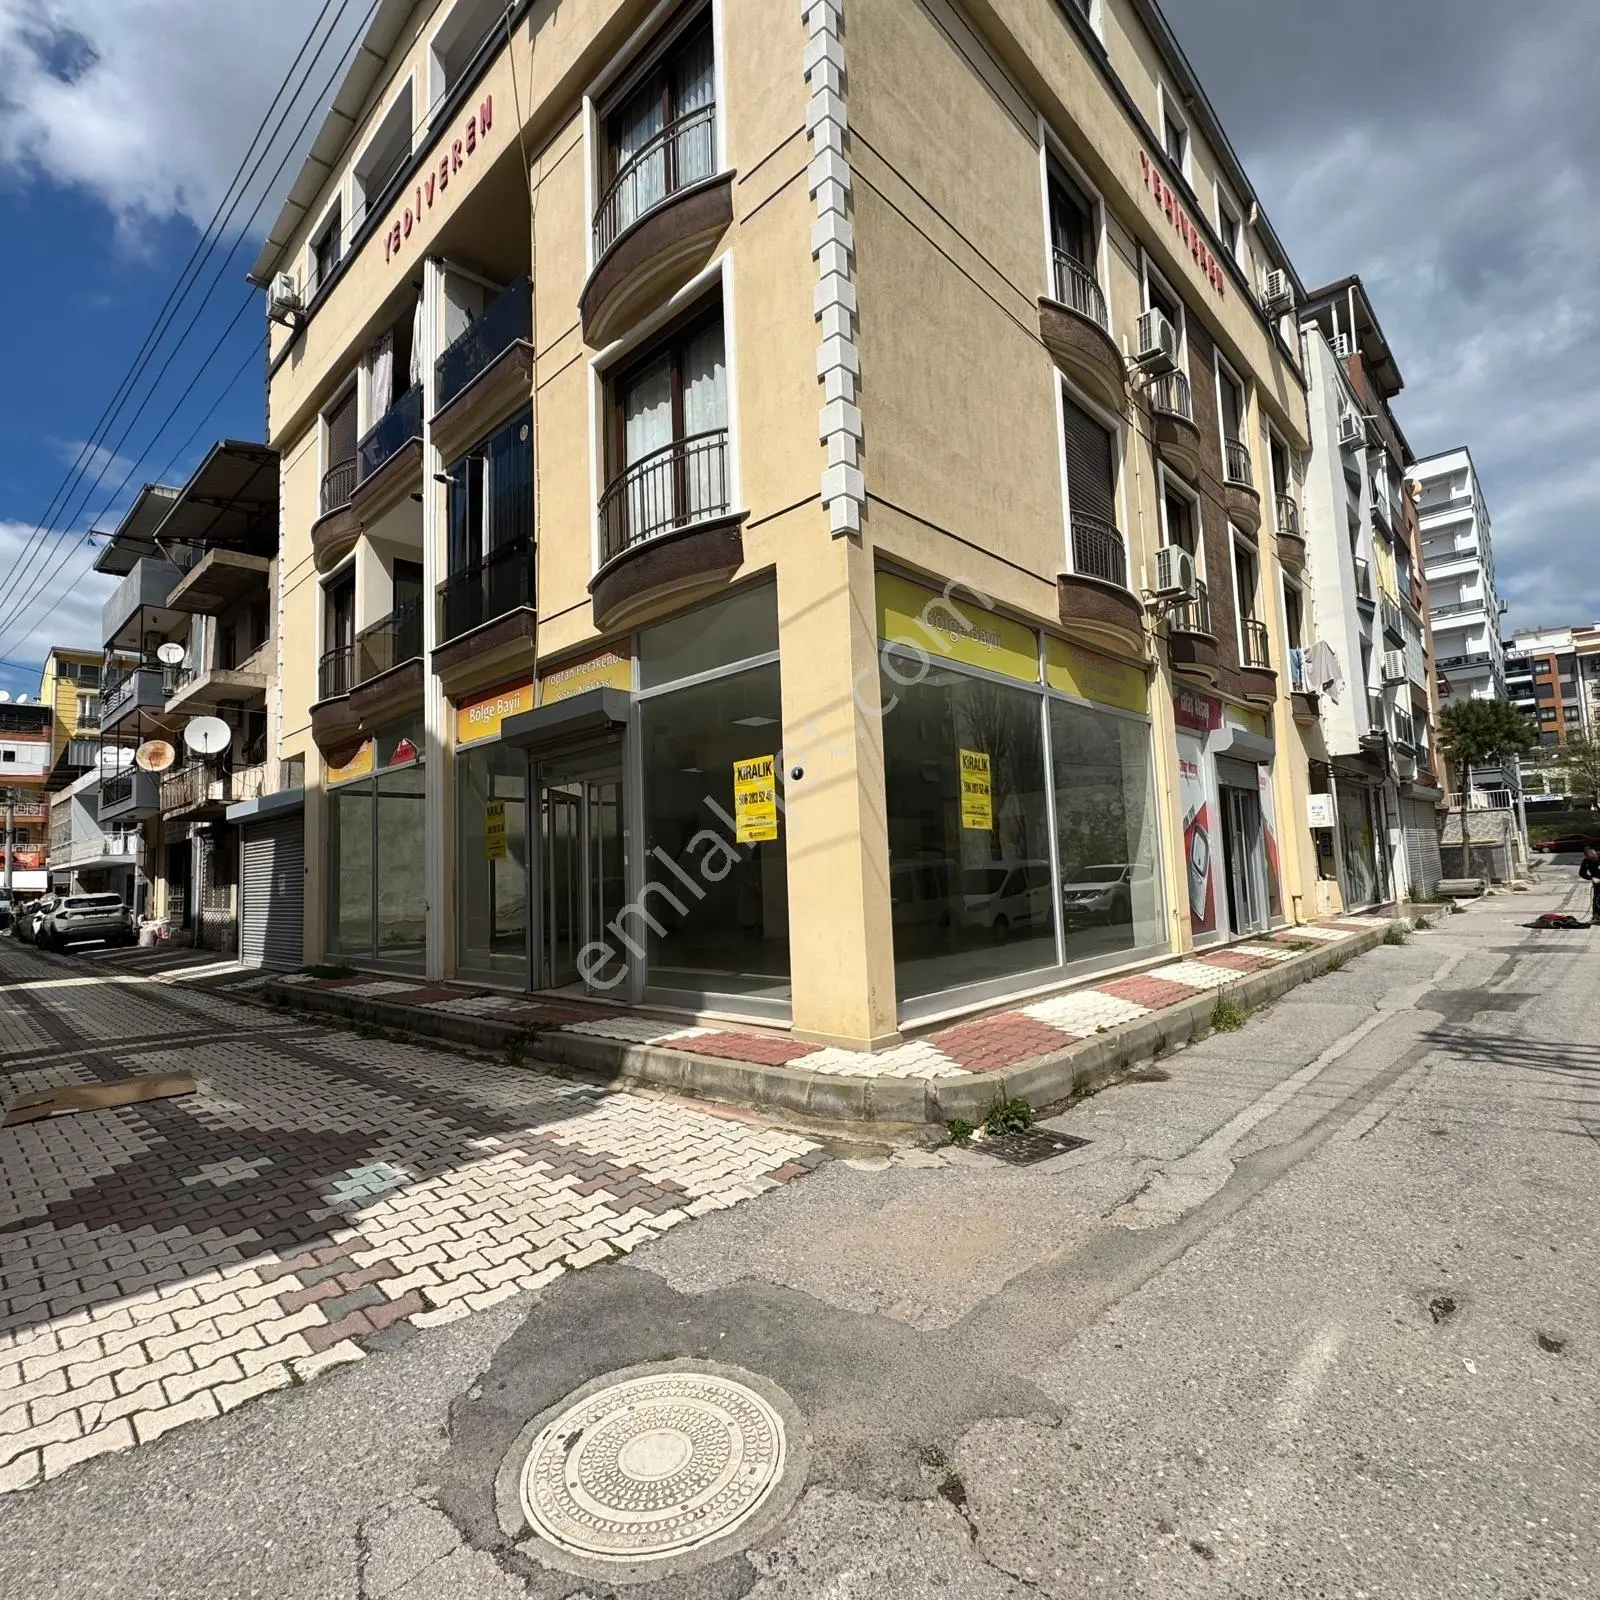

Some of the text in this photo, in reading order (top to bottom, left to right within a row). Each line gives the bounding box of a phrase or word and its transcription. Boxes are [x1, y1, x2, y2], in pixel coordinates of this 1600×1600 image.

[576, 651, 625, 676] Perakende
[469, 692, 520, 724] Bölge Bayii
